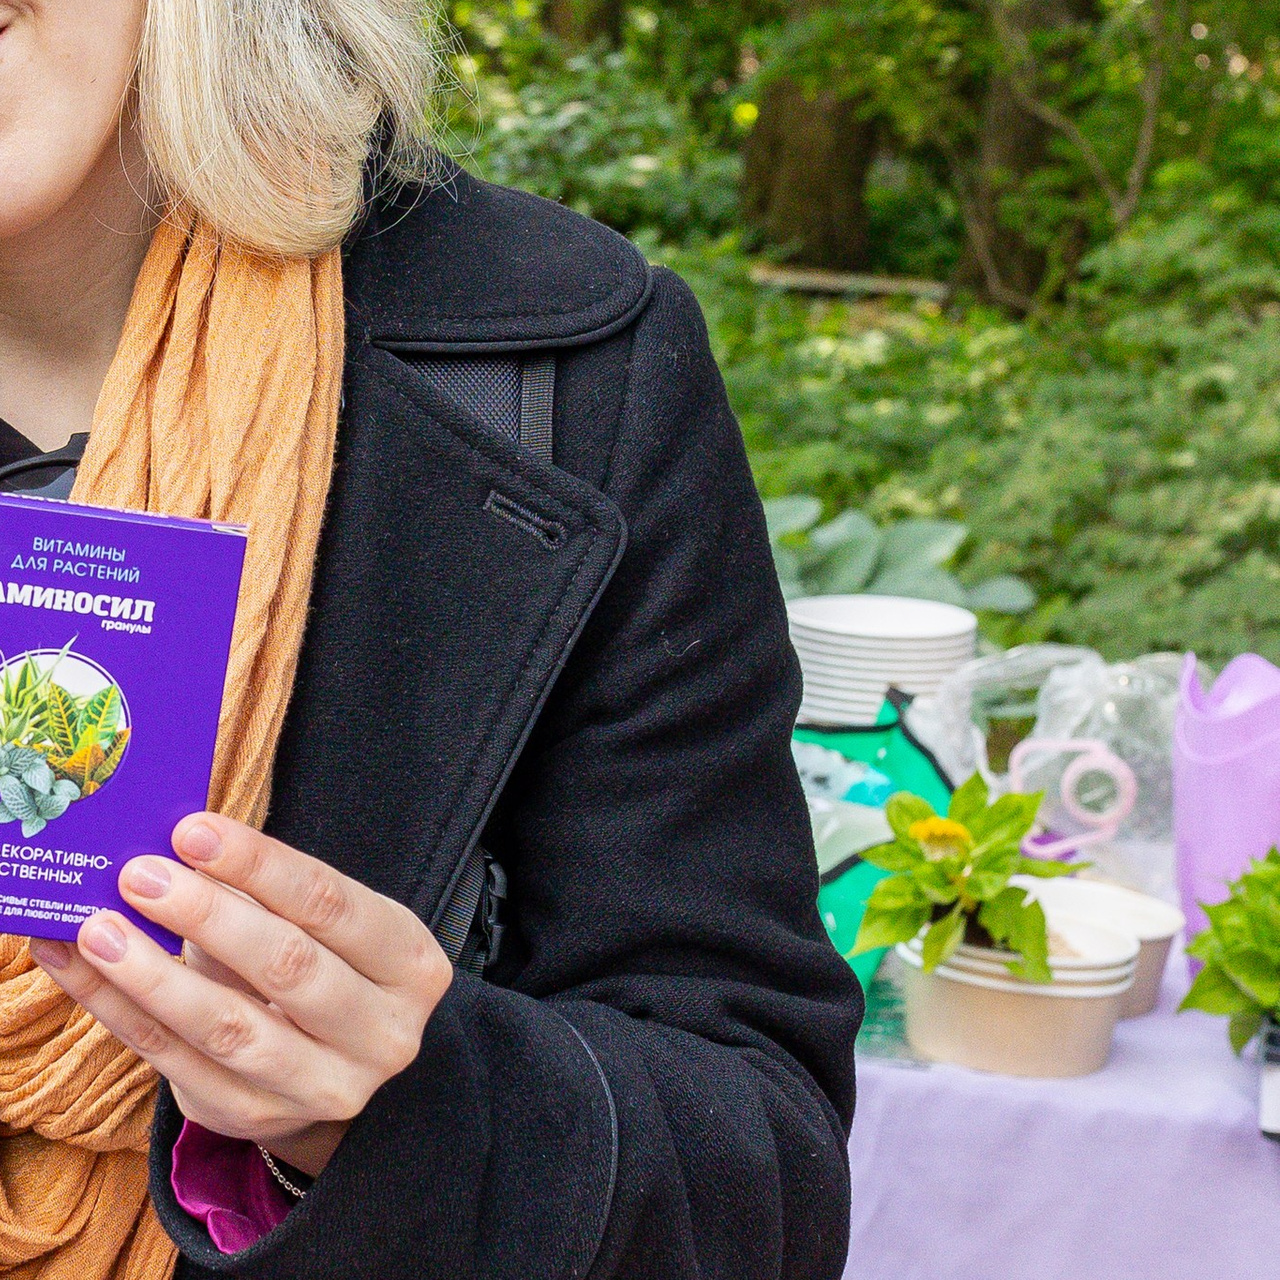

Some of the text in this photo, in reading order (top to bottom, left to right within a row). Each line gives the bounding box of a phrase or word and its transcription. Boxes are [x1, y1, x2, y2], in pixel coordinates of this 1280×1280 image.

[32, 537, 126, 562] ВИТАМИНЫ
[11, 554, 140, 583] ДЛЯ РАСТЕНИЙ
[101, 619, 152, 634] гранулы
[3, 906, 23, 916] ДЛЯ
[24, 909, 60, 921] ЛЮБОГО
[61, 913, 86, 923] ВОЗР
[29, 899, 64, 911] СТЕБЛИ
[64, 903, 72, 911] И
[73, 904, 108, 914] ЛИСТ
